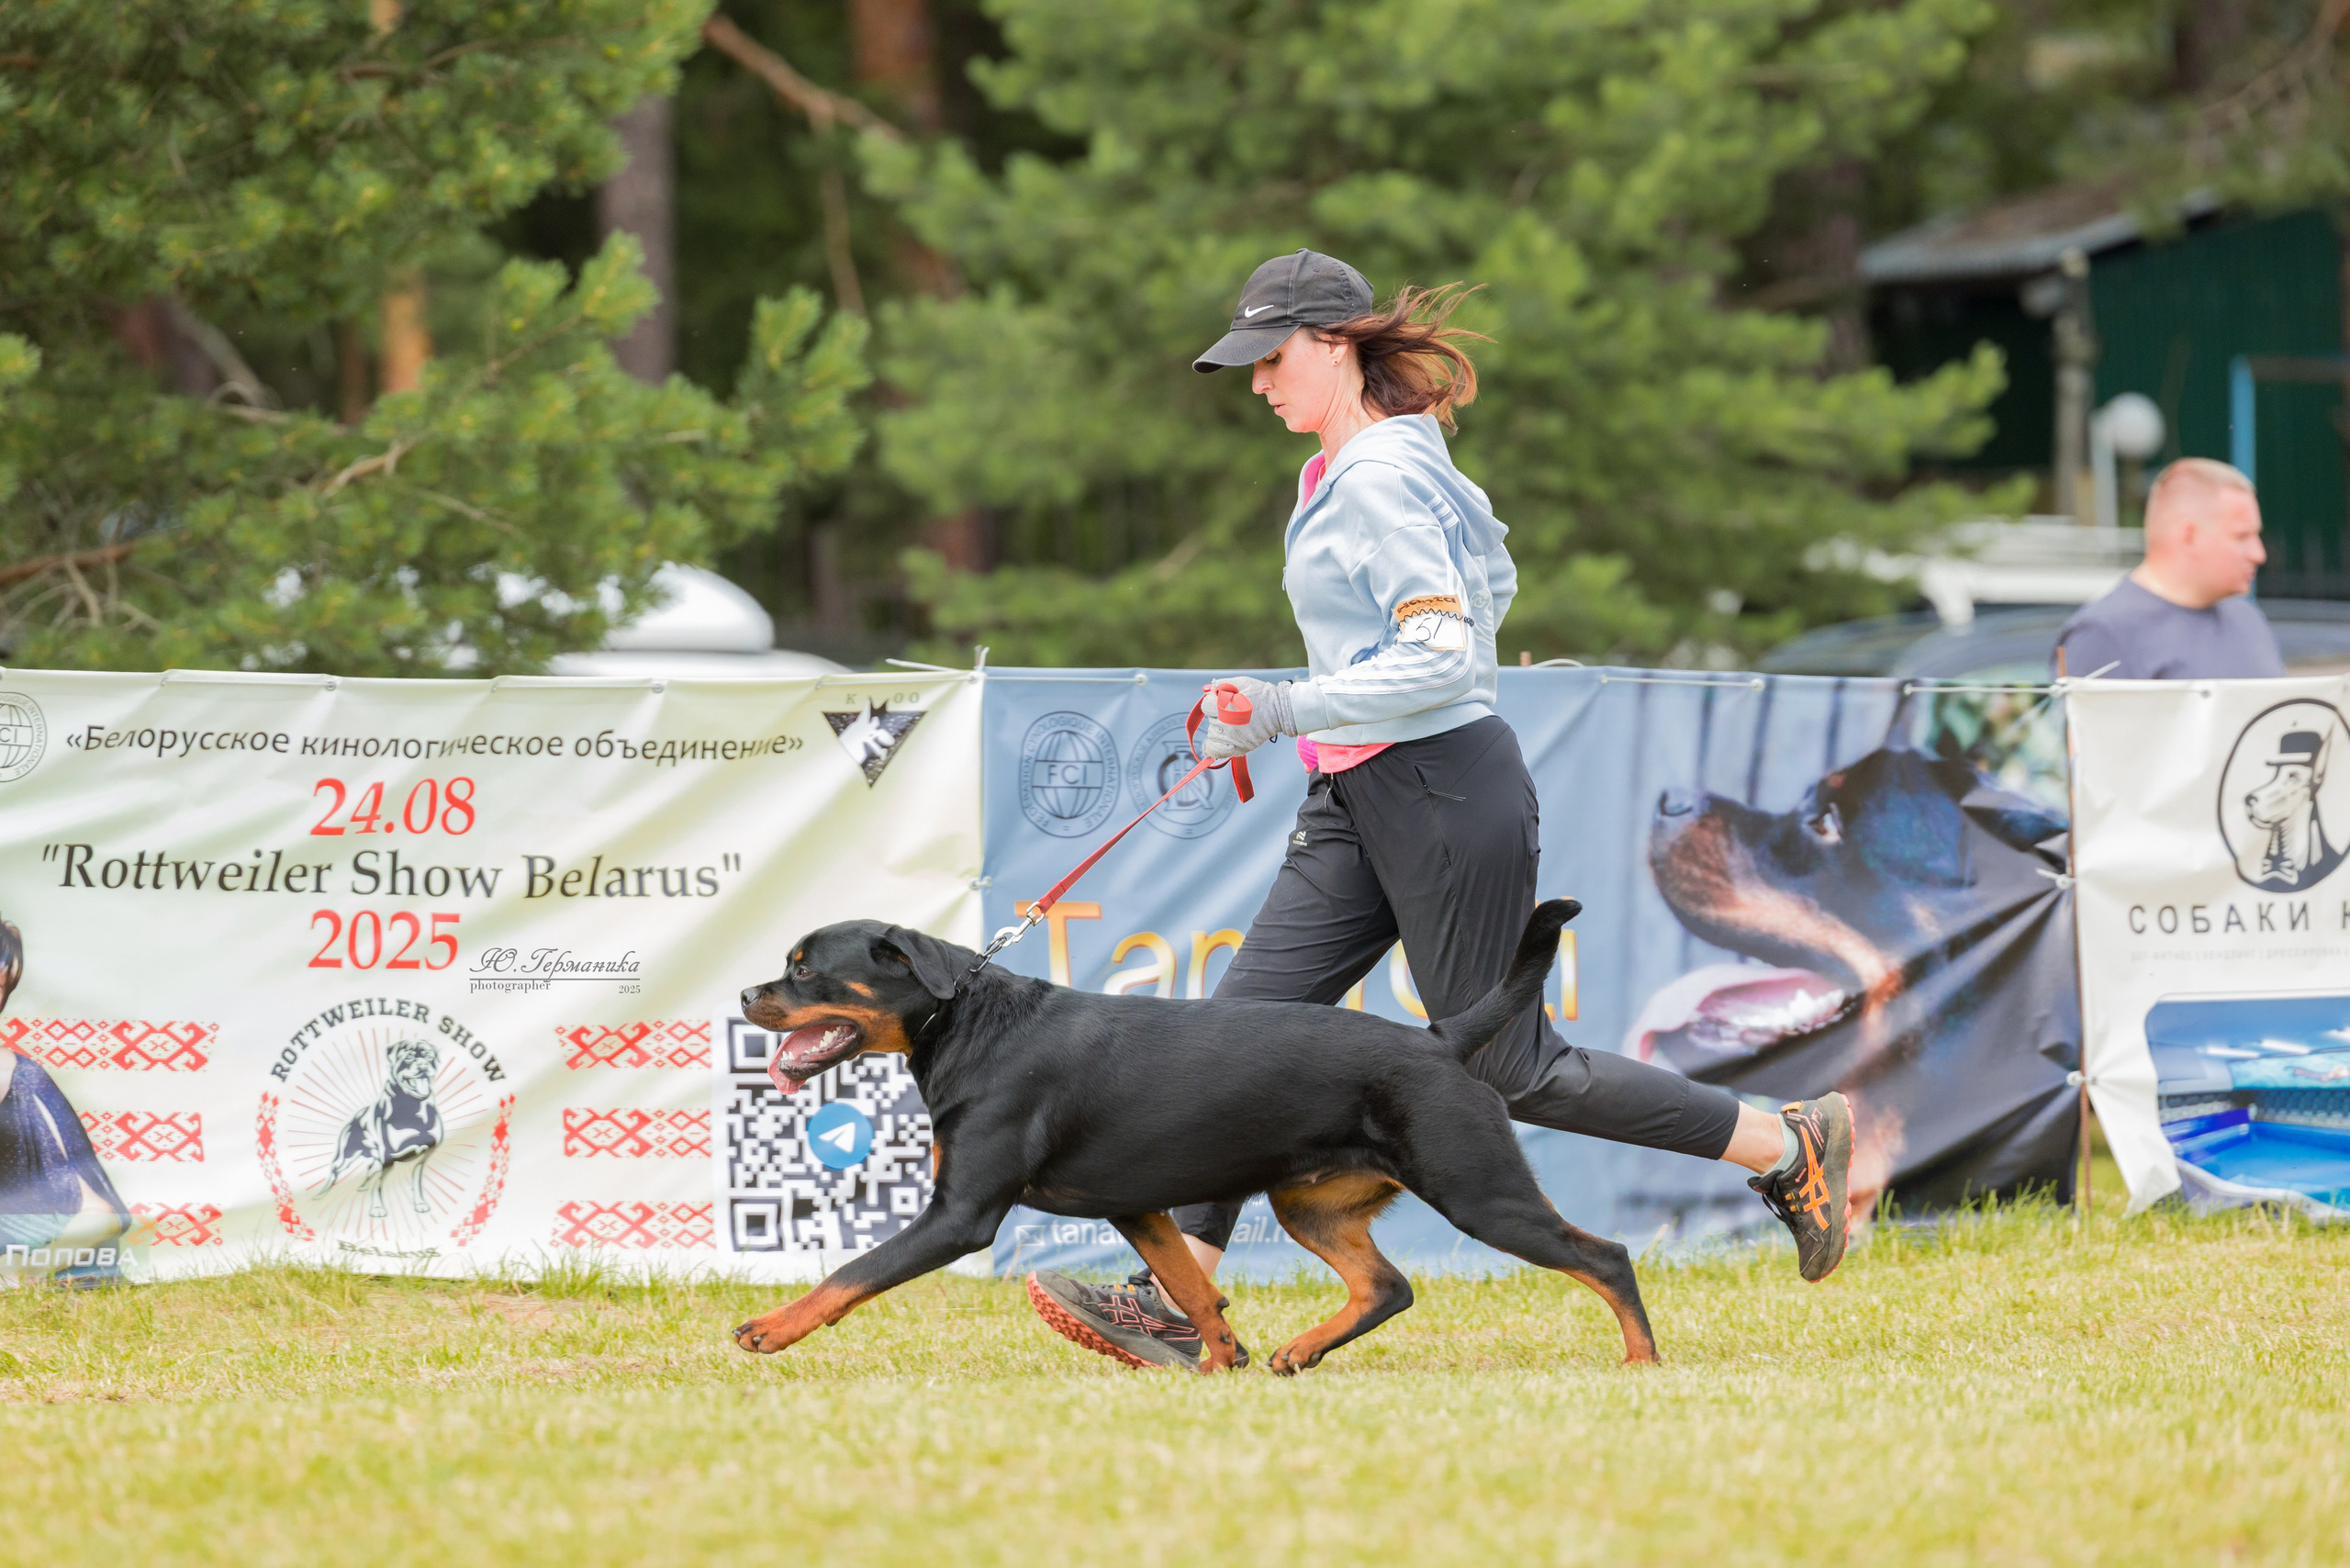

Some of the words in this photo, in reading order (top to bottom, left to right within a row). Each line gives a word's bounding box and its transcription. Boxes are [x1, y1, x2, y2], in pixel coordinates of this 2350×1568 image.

[66, 725, 290, 757] «Белорусское
[301, 732, 563, 760] кинологическое
[574, 730, 804, 766] объединение»
[1047, 764, 1088, 785] FCI
[309, 777, 476, 836] 24.08
[42, 843, 333, 894] "Rottweiler
[351, 849, 503, 899] Show
[521, 852, 742, 900] Belarus"
[308, 909, 461, 970] 2025
[2129, 902, 2310, 935] СОБАКИ
[270, 997, 431, 1083] ROTTWEILER
[438, 1014, 507, 1083] SHOW
